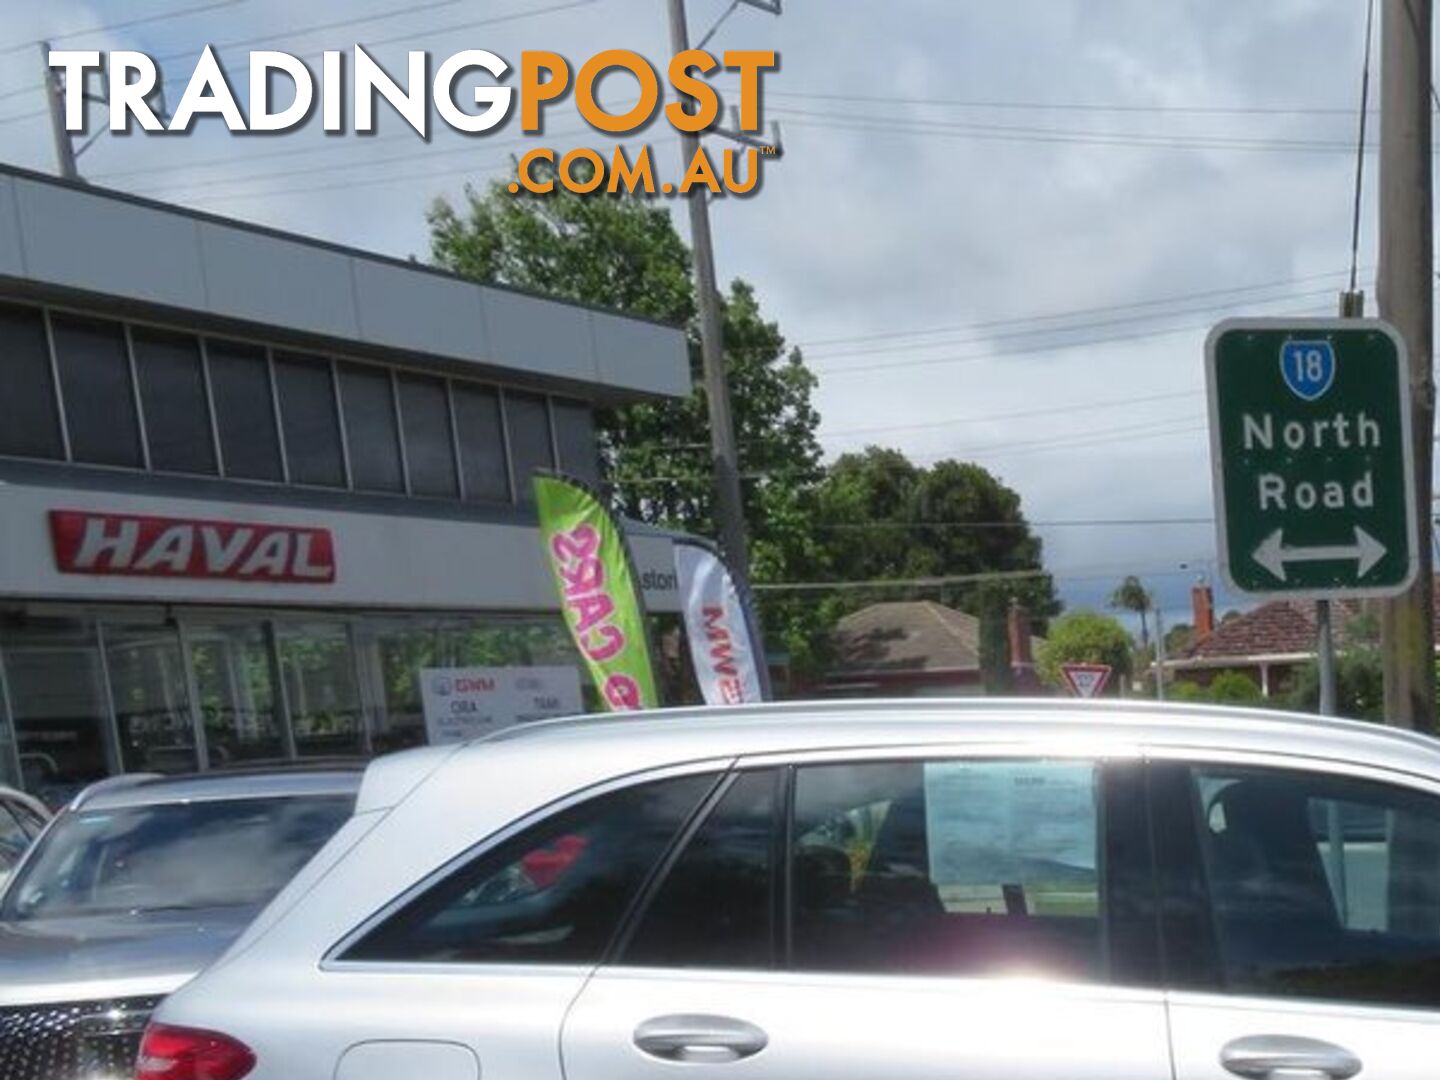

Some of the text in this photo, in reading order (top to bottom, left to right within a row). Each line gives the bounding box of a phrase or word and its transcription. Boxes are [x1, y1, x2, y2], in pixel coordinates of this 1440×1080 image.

[1293, 349, 1324, 383] 18
[1242, 411, 1381, 450] North
[1258, 471, 1374, 510] Road
[74, 518, 333, 577] HAVAL
